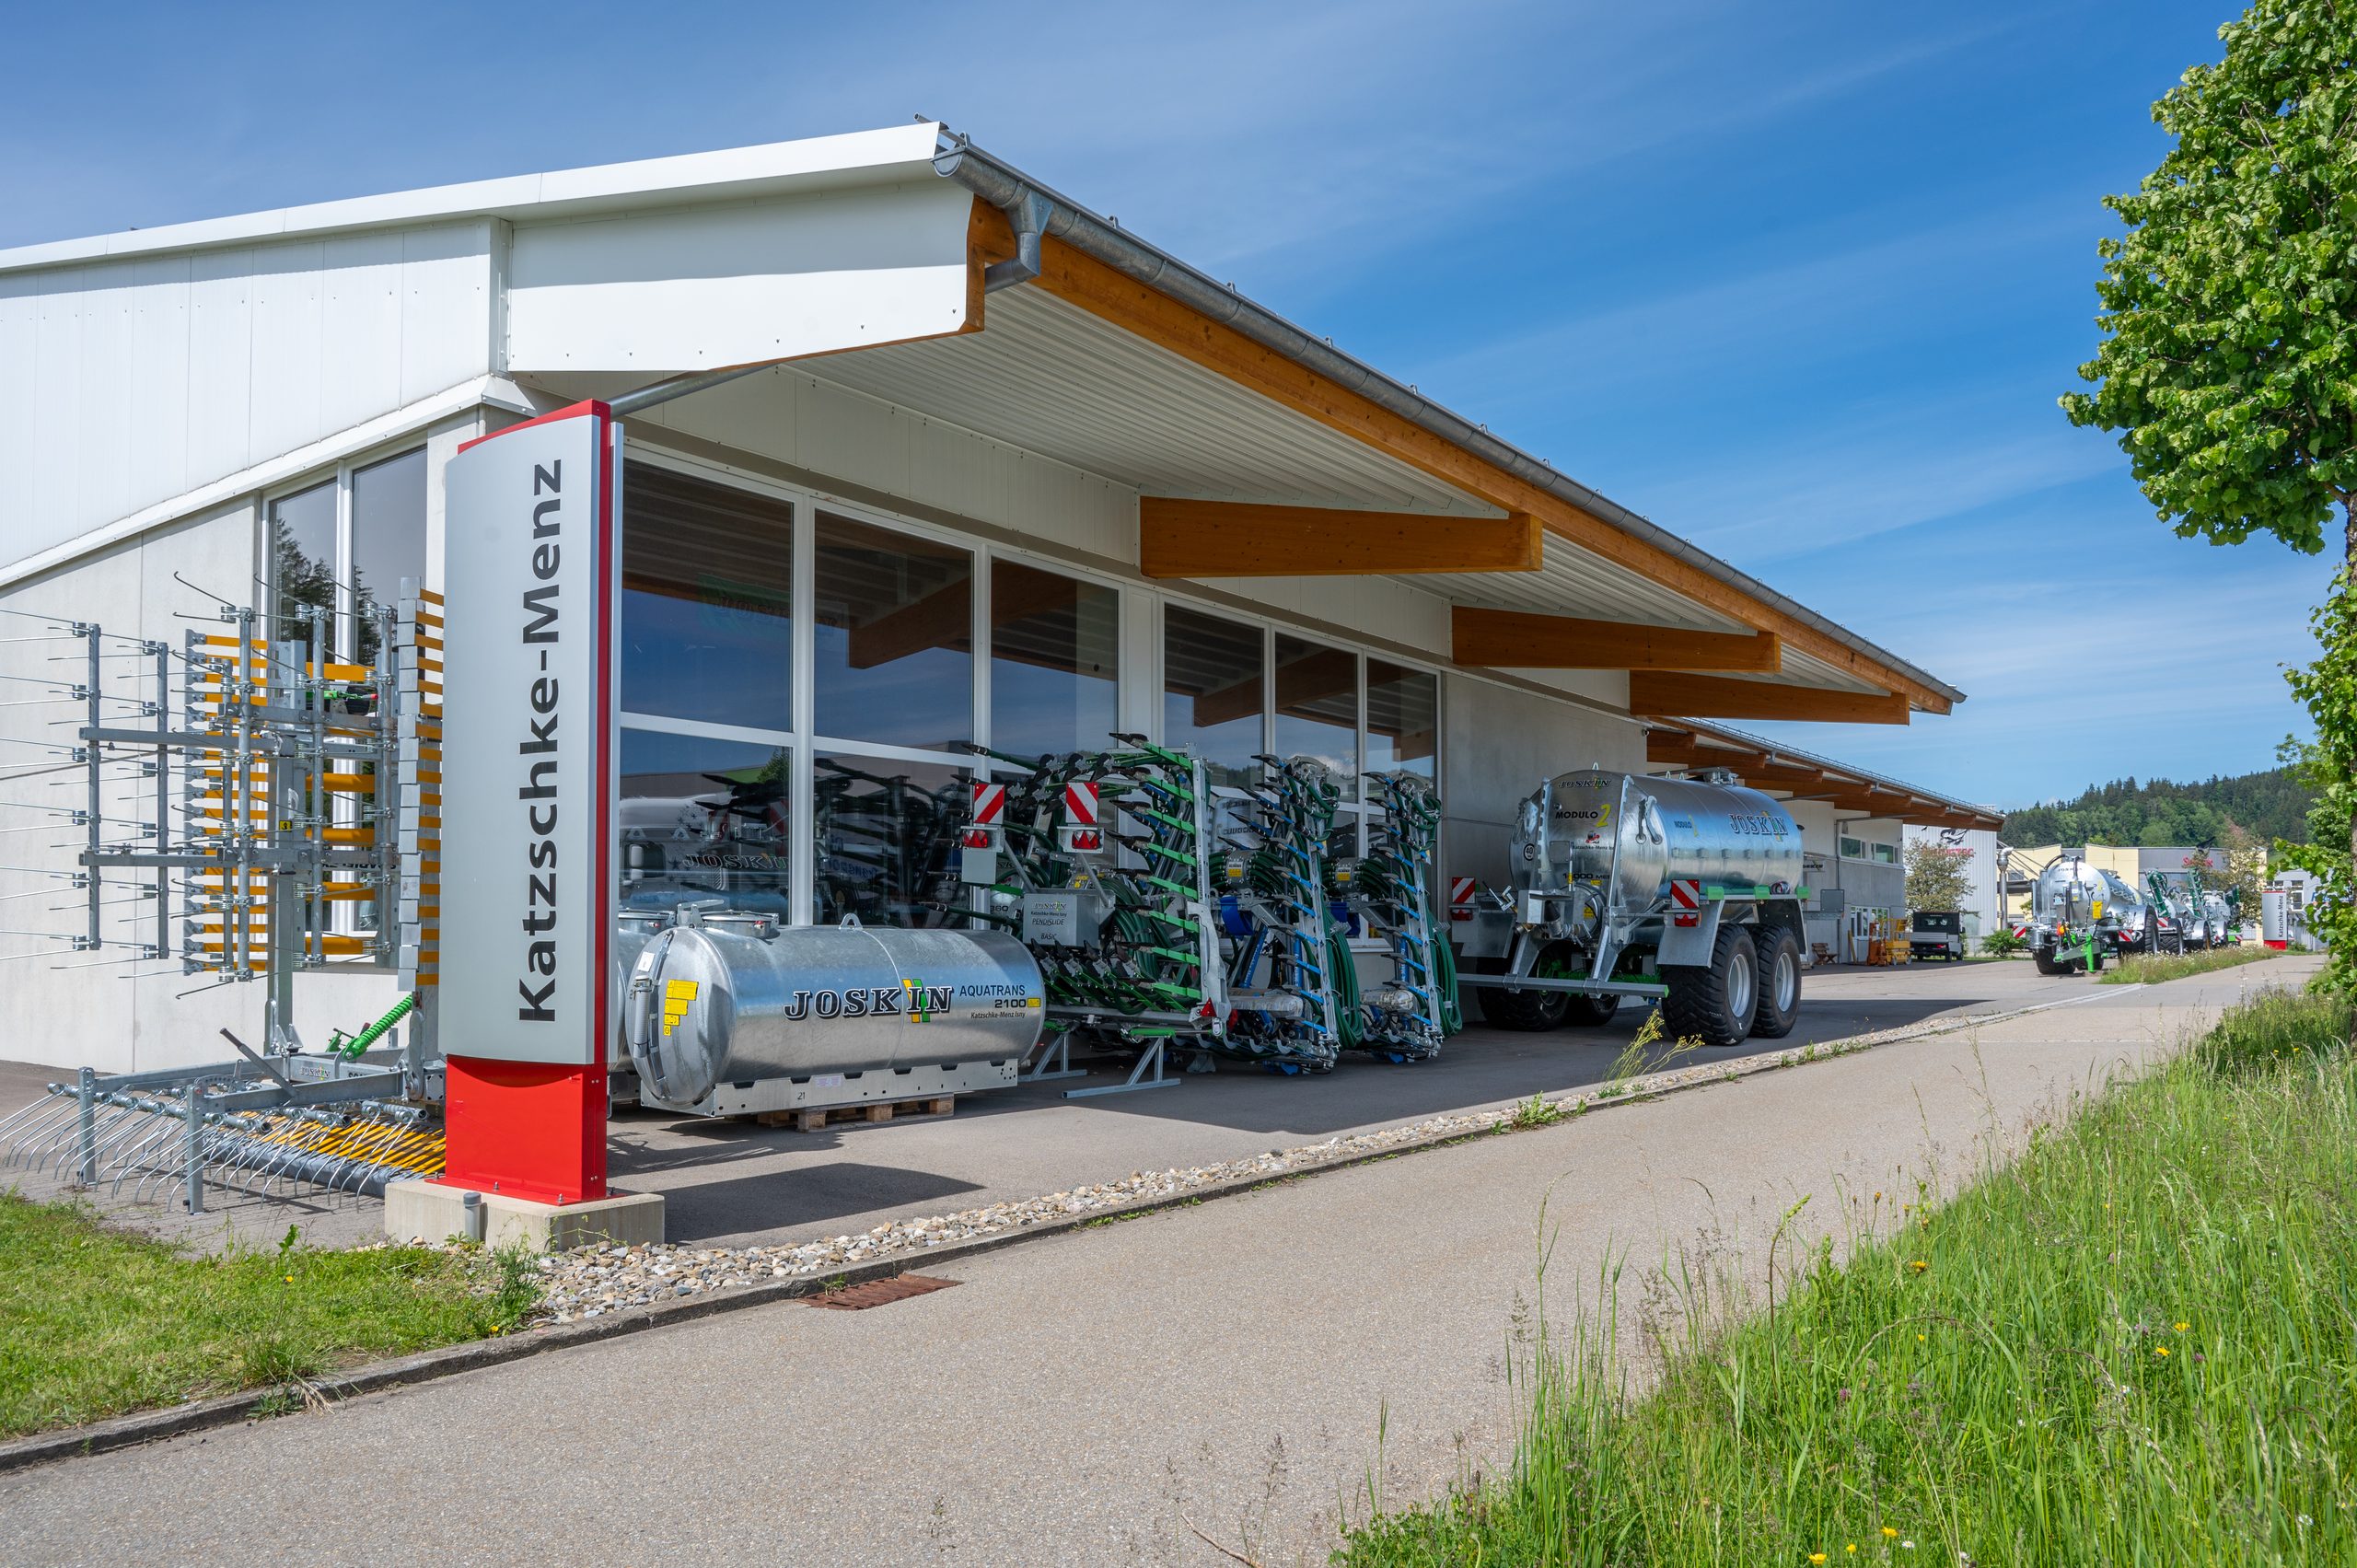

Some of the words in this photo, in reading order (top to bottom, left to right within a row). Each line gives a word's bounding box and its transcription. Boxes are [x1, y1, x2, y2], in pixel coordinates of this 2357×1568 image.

[518, 459, 563, 1023] Katzschke-Menz
[1558, 779, 1611, 789] JOSKIN
[1596, 804, 1611, 828] 2
[1728, 814, 1788, 836] JOSKIN
[959, 984, 1026, 997] AQUATRANS
[784, 985, 954, 1020] JOSKIN
[994, 999, 1027, 1008] 2100
[797, 1091, 806, 1100] 21
